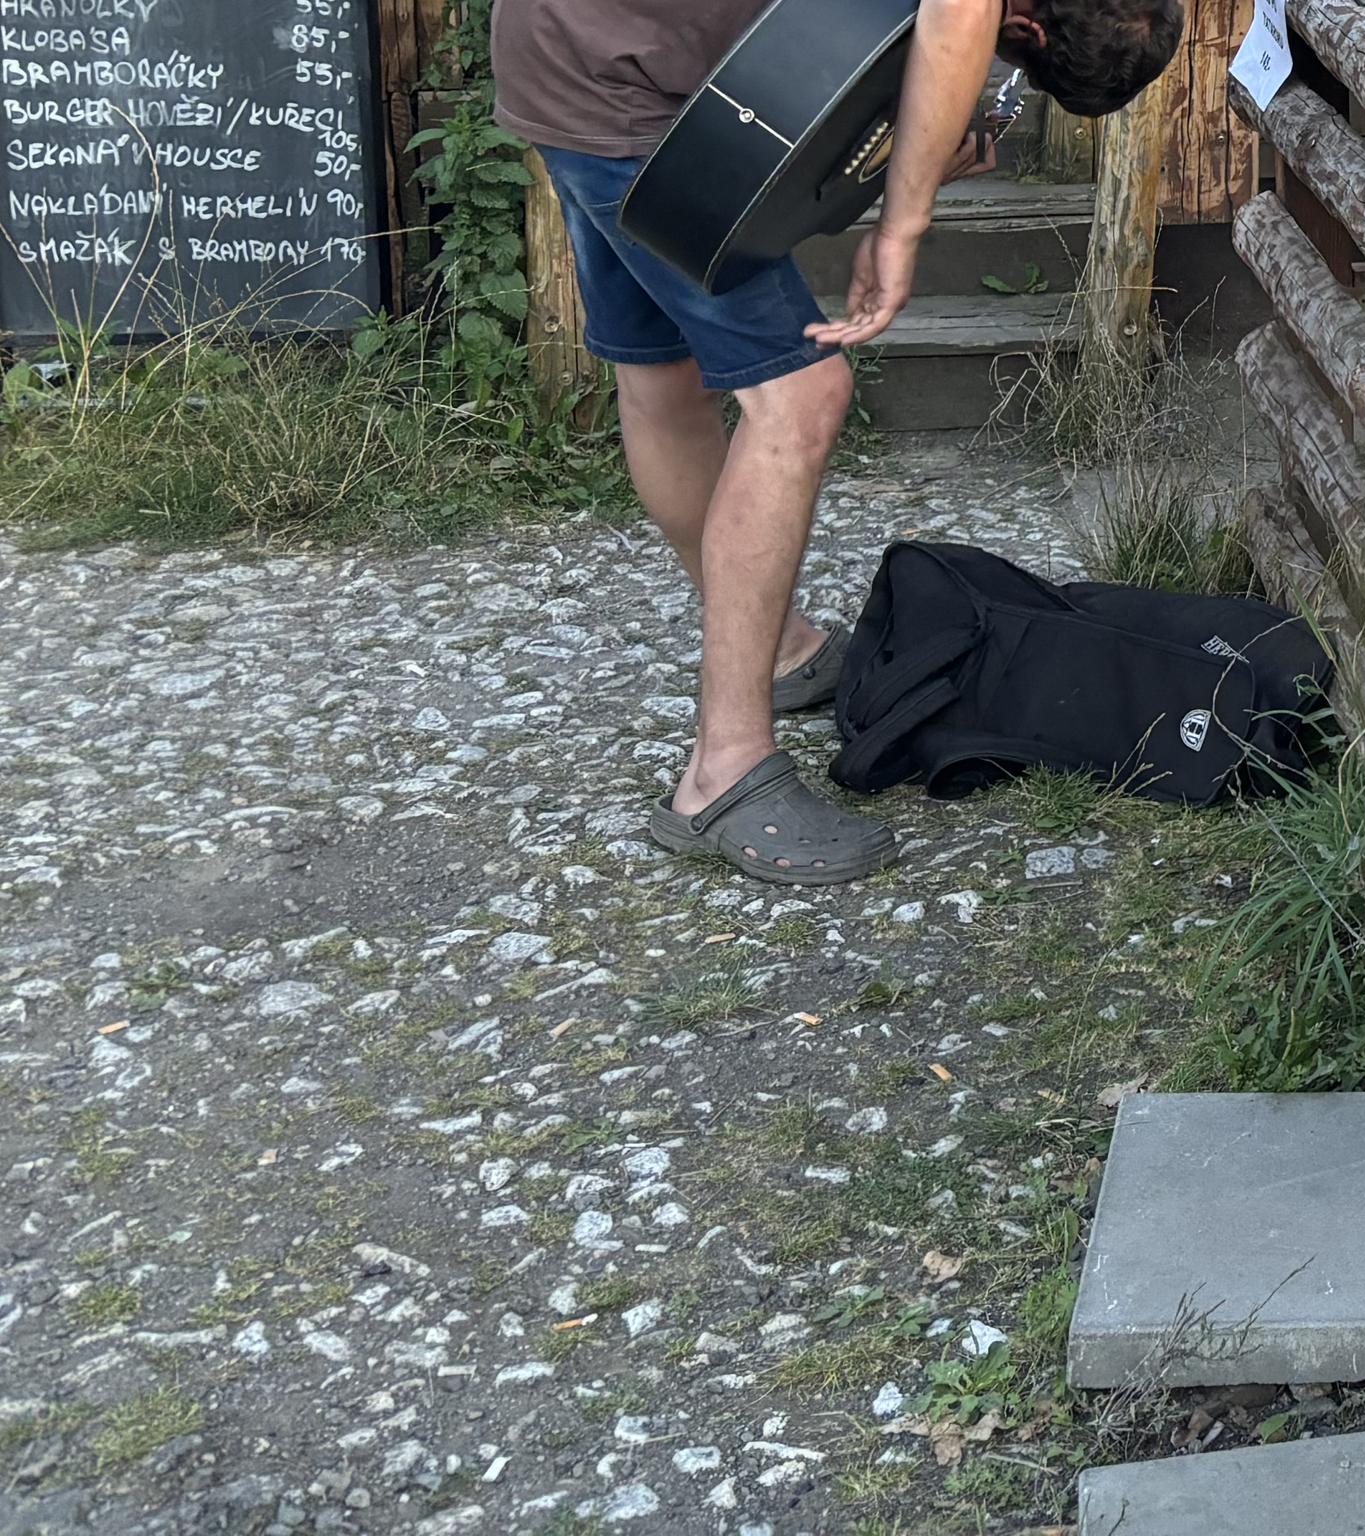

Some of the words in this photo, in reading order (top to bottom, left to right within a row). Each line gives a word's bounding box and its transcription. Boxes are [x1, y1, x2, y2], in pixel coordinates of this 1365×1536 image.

[4, 99, 115, 128] BURGER
[155, 145, 262, 171] HOUSCE
[19, 228, 138, 266] SMAŽÁK
